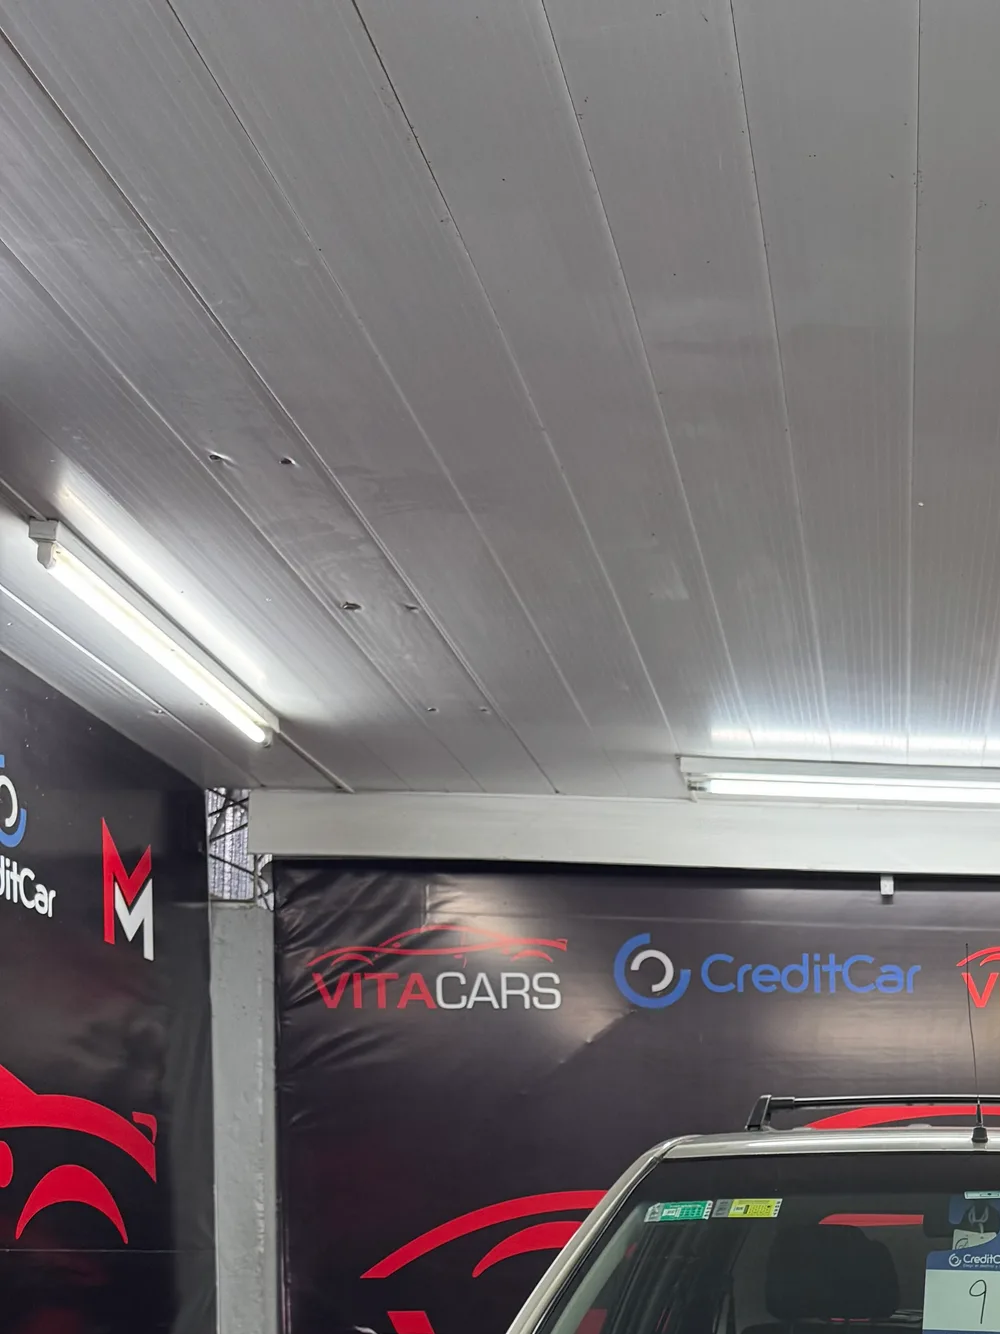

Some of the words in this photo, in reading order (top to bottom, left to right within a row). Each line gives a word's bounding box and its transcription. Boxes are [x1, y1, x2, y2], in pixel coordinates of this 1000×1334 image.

[311, 971, 562, 1011] VITACARS
[700, 953, 922, 995] CreditCar
[968, 1279, 987, 1325] 9
